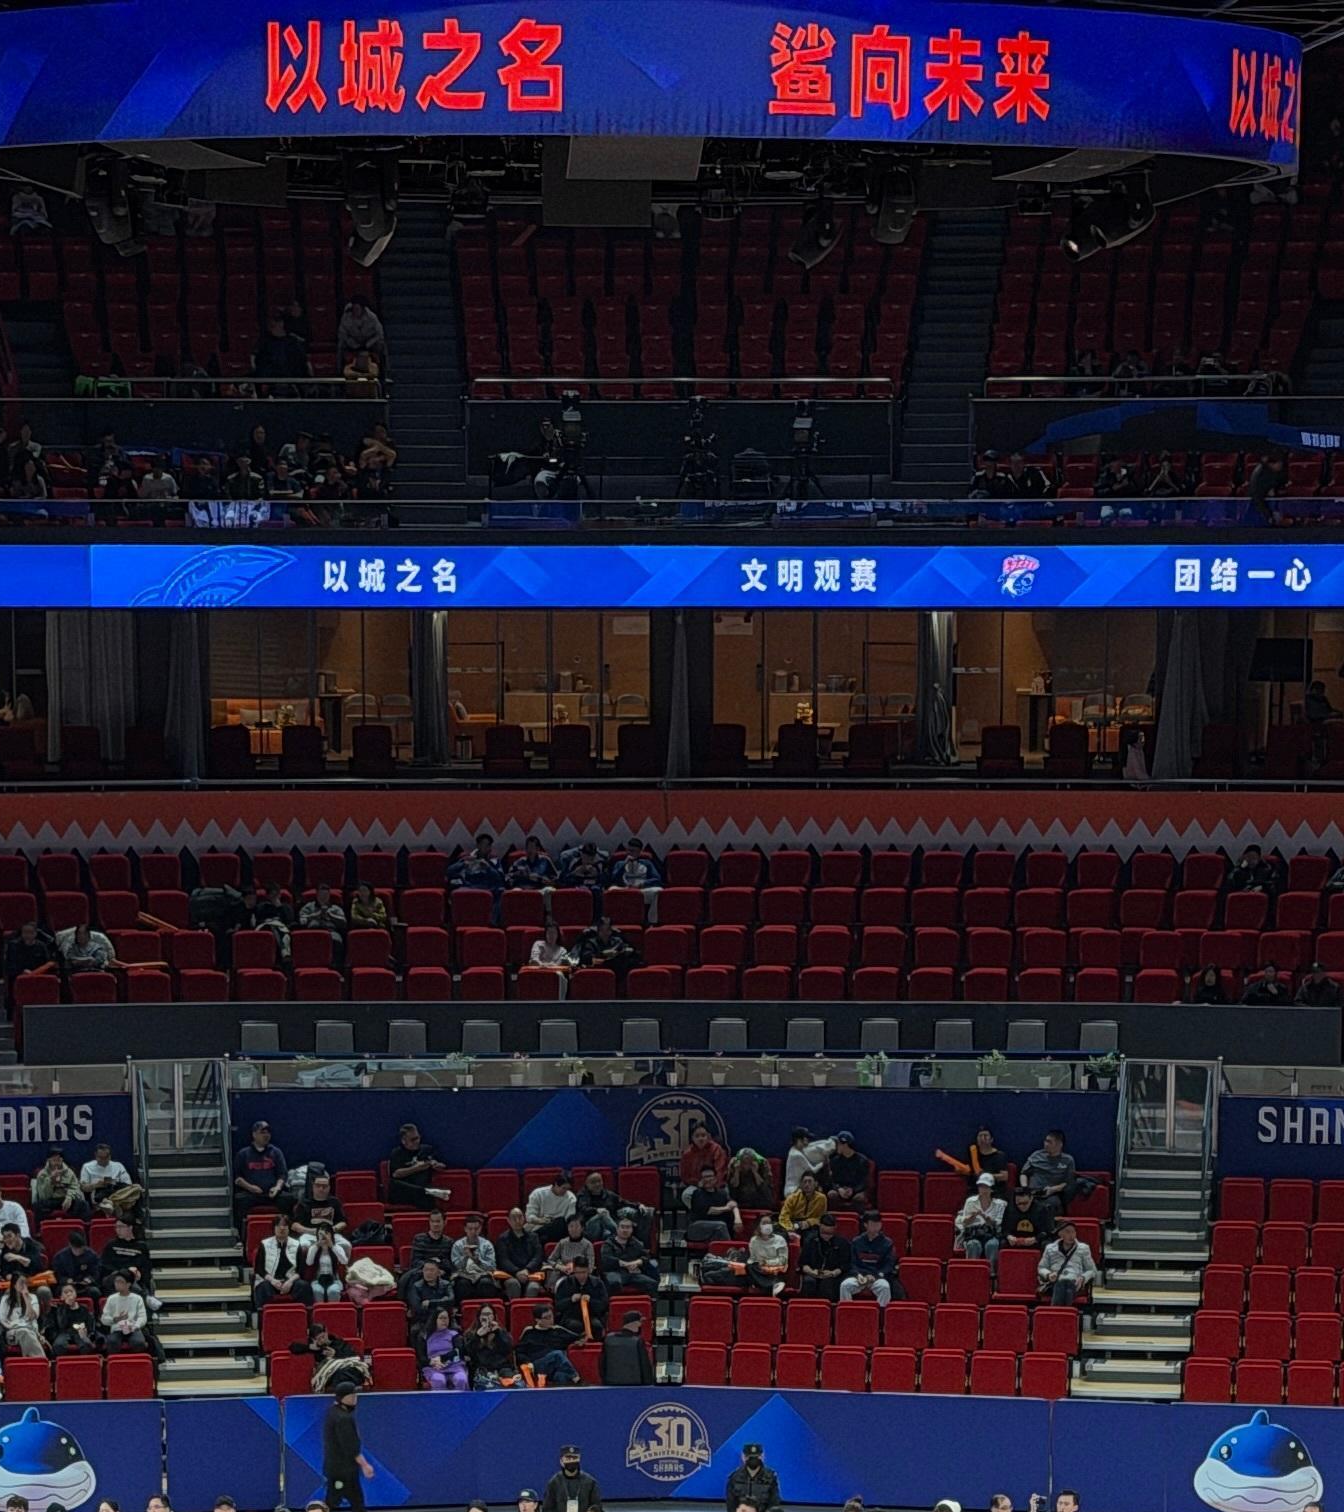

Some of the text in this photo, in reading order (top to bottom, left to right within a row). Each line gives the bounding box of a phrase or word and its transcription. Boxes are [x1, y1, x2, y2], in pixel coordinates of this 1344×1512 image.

[266, 18, 563, 113] 以城之名
[768, 22, 1050, 123] 鲨向未来
[322, 558, 458, 593] 以城之名
[740, 558, 878, 593] 文明观赛
[1174, 557, 1312, 593] 团结一心
[646, 1415, 693, 1450] 30
